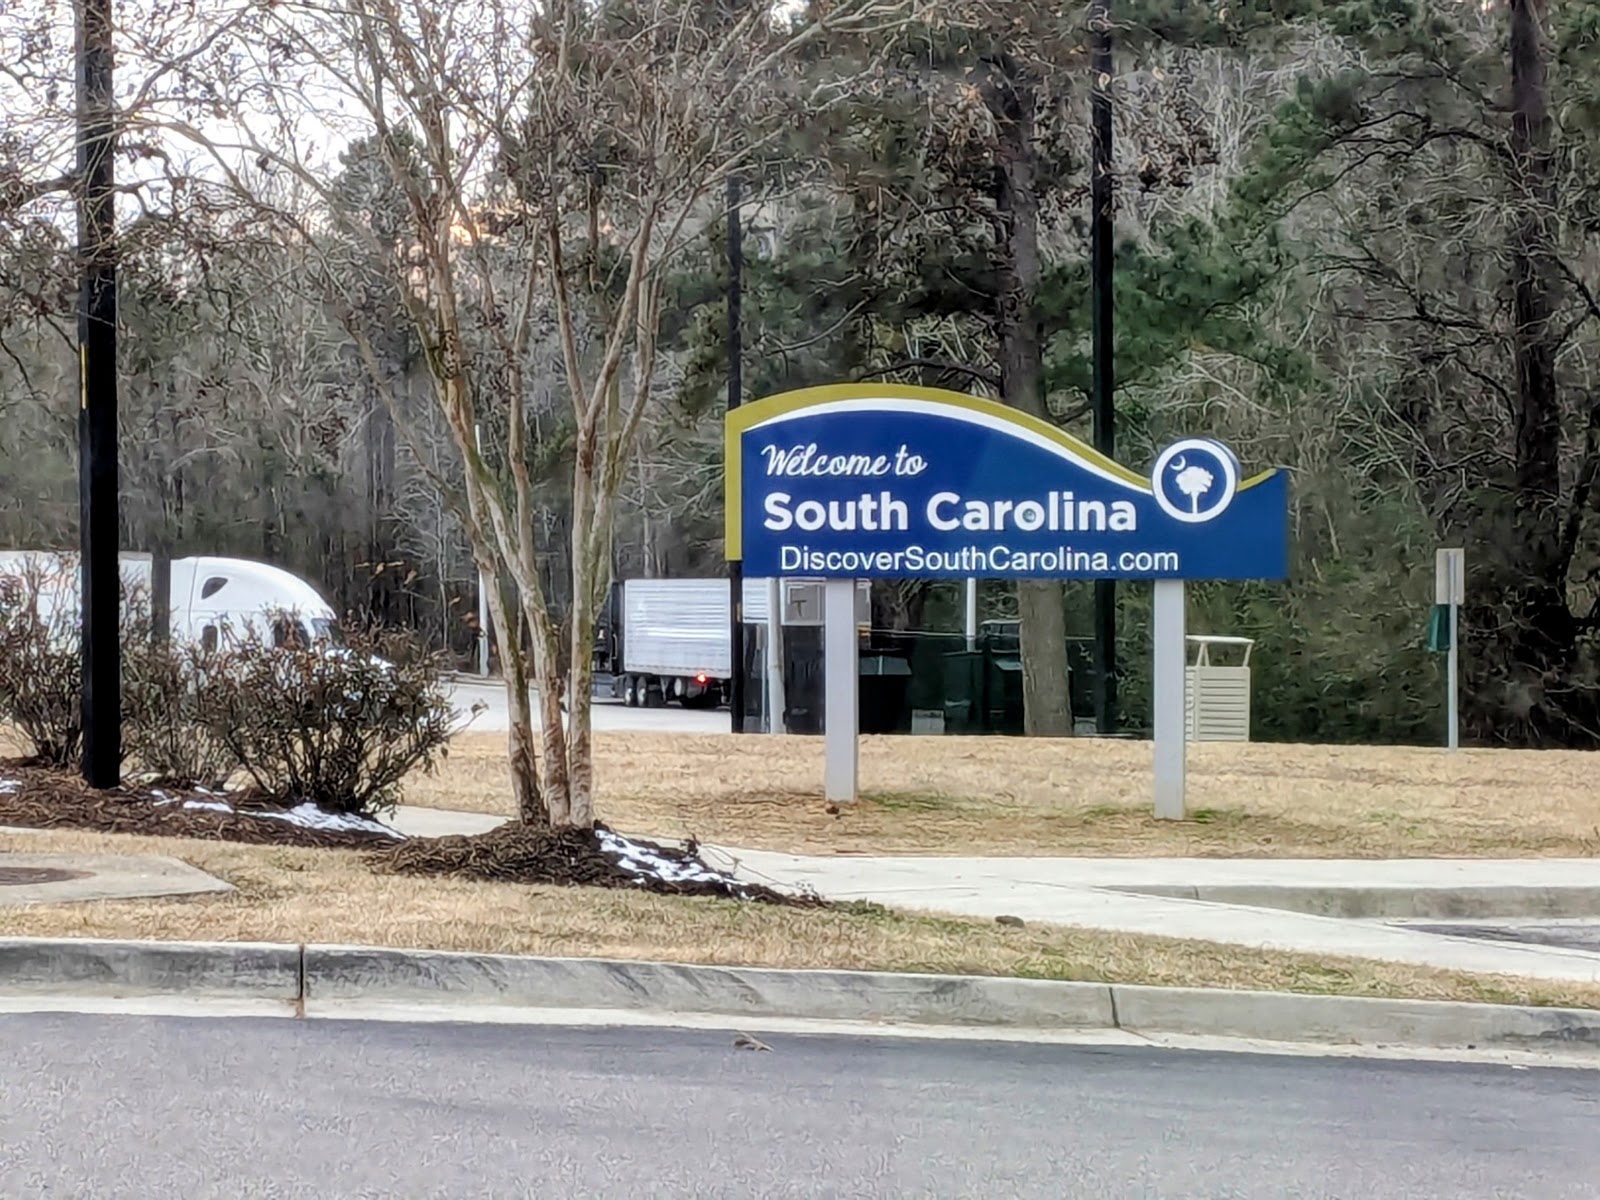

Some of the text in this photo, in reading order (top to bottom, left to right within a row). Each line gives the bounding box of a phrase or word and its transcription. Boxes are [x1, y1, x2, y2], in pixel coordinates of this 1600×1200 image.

[761, 443, 928, 476] Welcome to
[763, 491, 1137, 532] South Carolina
[780, 545, 1180, 571] DiscoverSouthCarolina.com
